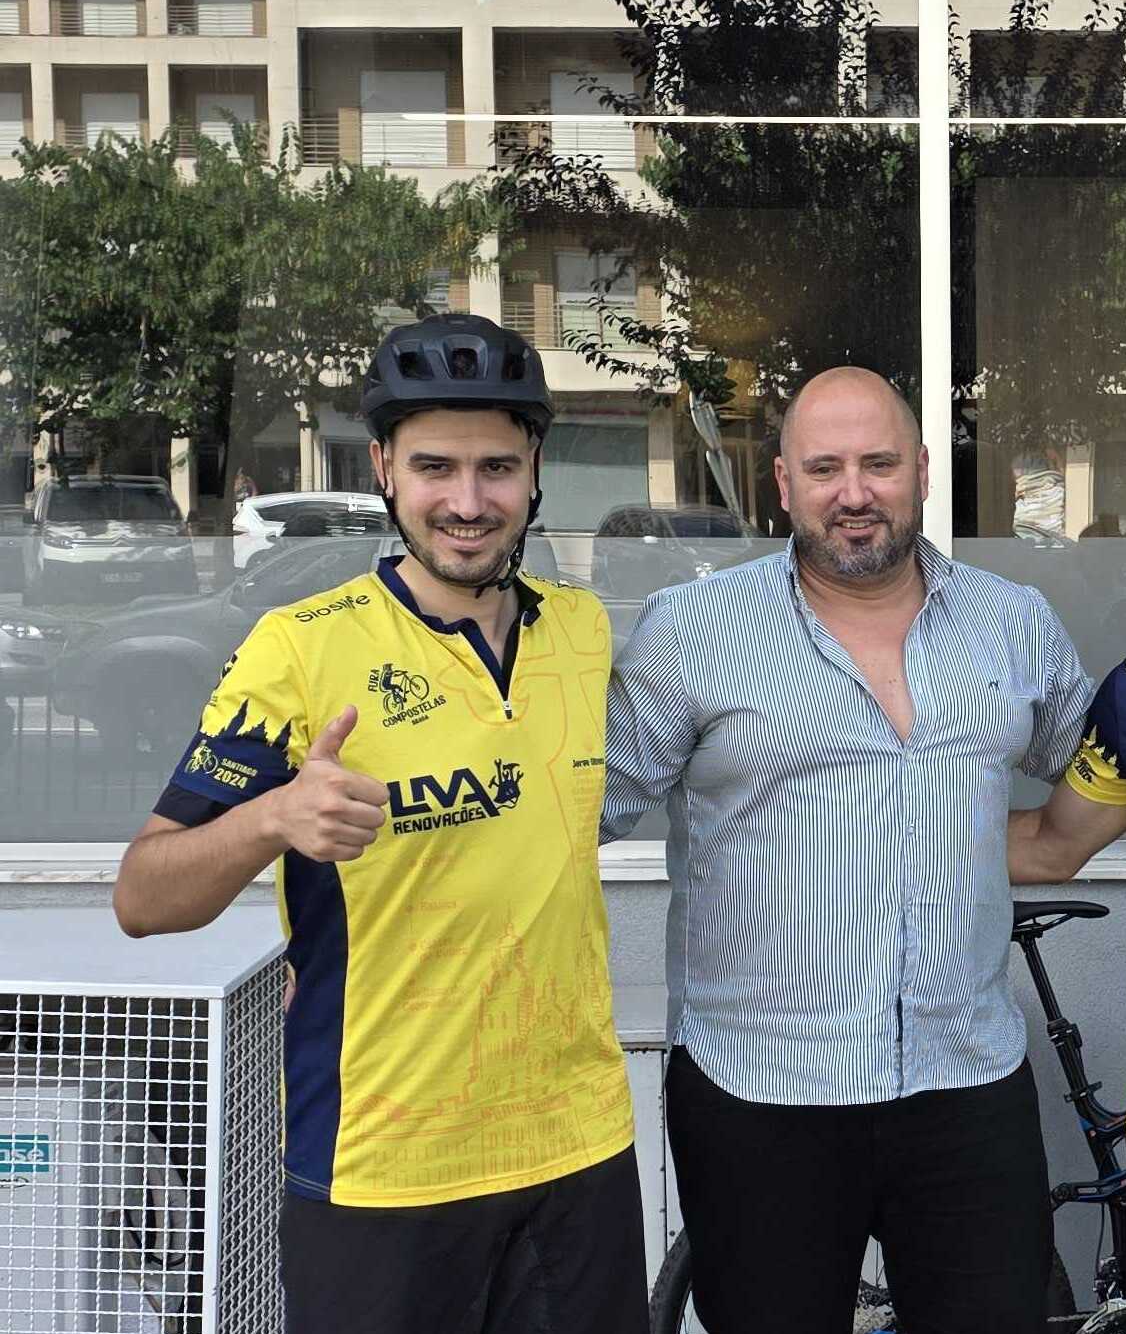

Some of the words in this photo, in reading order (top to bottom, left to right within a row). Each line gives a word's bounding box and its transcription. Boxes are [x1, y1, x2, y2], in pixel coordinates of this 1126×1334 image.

[367, 668, 380, 693] FURA
[382, 694, 447, 728] COMPOSTELAS
[213, 767, 249, 789] 2024
[392, 806, 487, 836] RENOVAÇÕES
